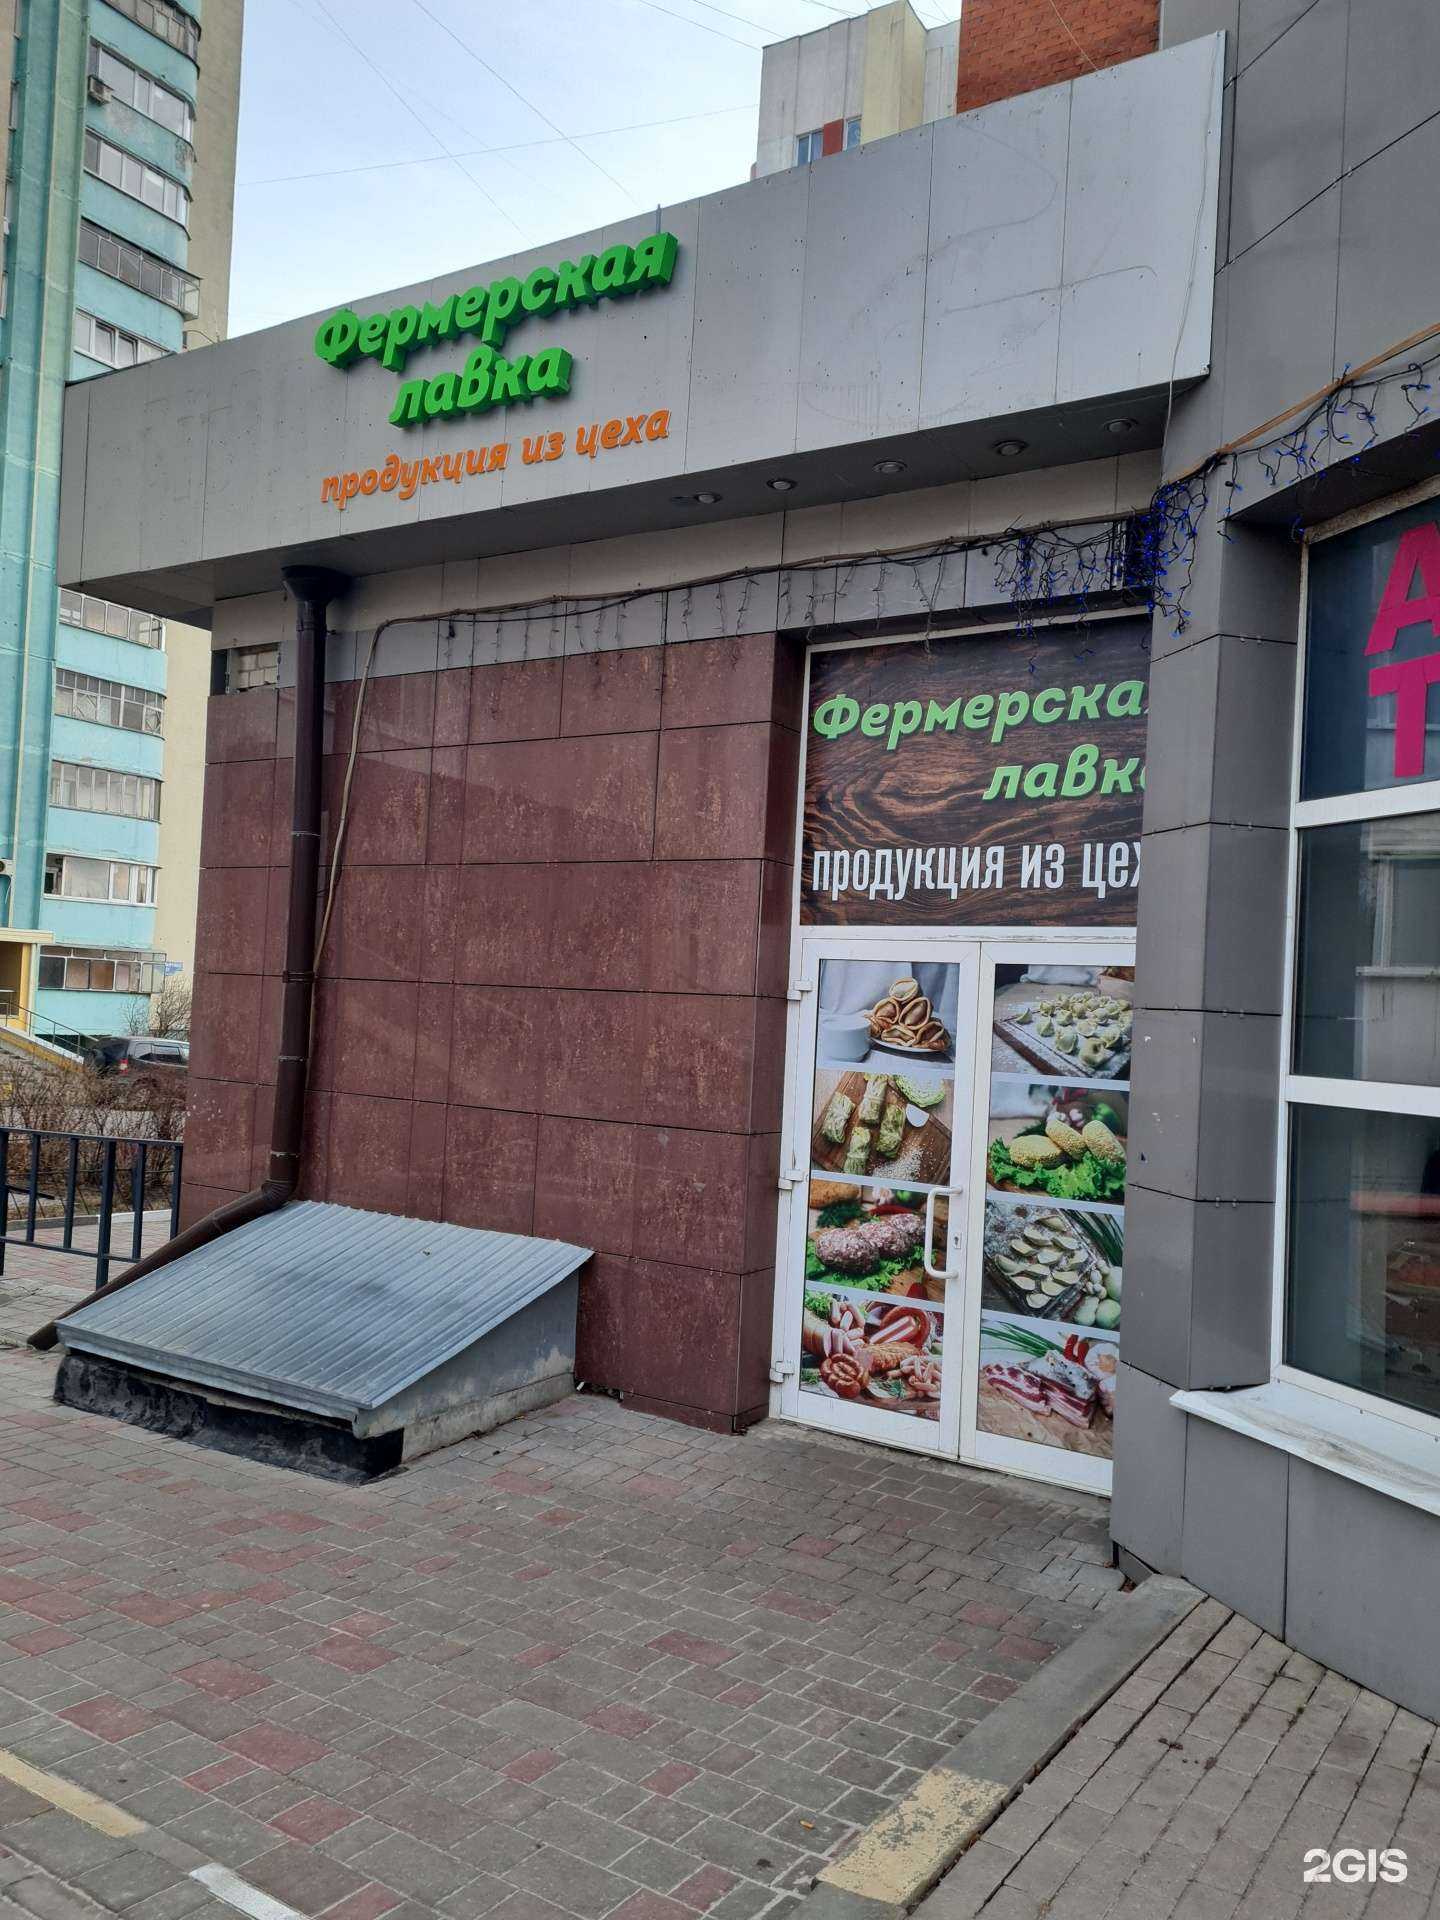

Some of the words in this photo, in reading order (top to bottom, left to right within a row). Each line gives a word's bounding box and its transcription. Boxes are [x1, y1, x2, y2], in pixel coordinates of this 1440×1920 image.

[314, 231, 679, 372] Фермерская
[388, 344, 573, 429] лавка
[320, 442, 509, 510] продукция
[521, 430, 567, 465] из
[575, 408, 672, 458] цеха
[812, 679, 1149, 751] Фермерска
[982, 743, 1146, 800] лавк
[812, 845, 1004, 901] продукция
[1020, 843, 1065, 889] из
